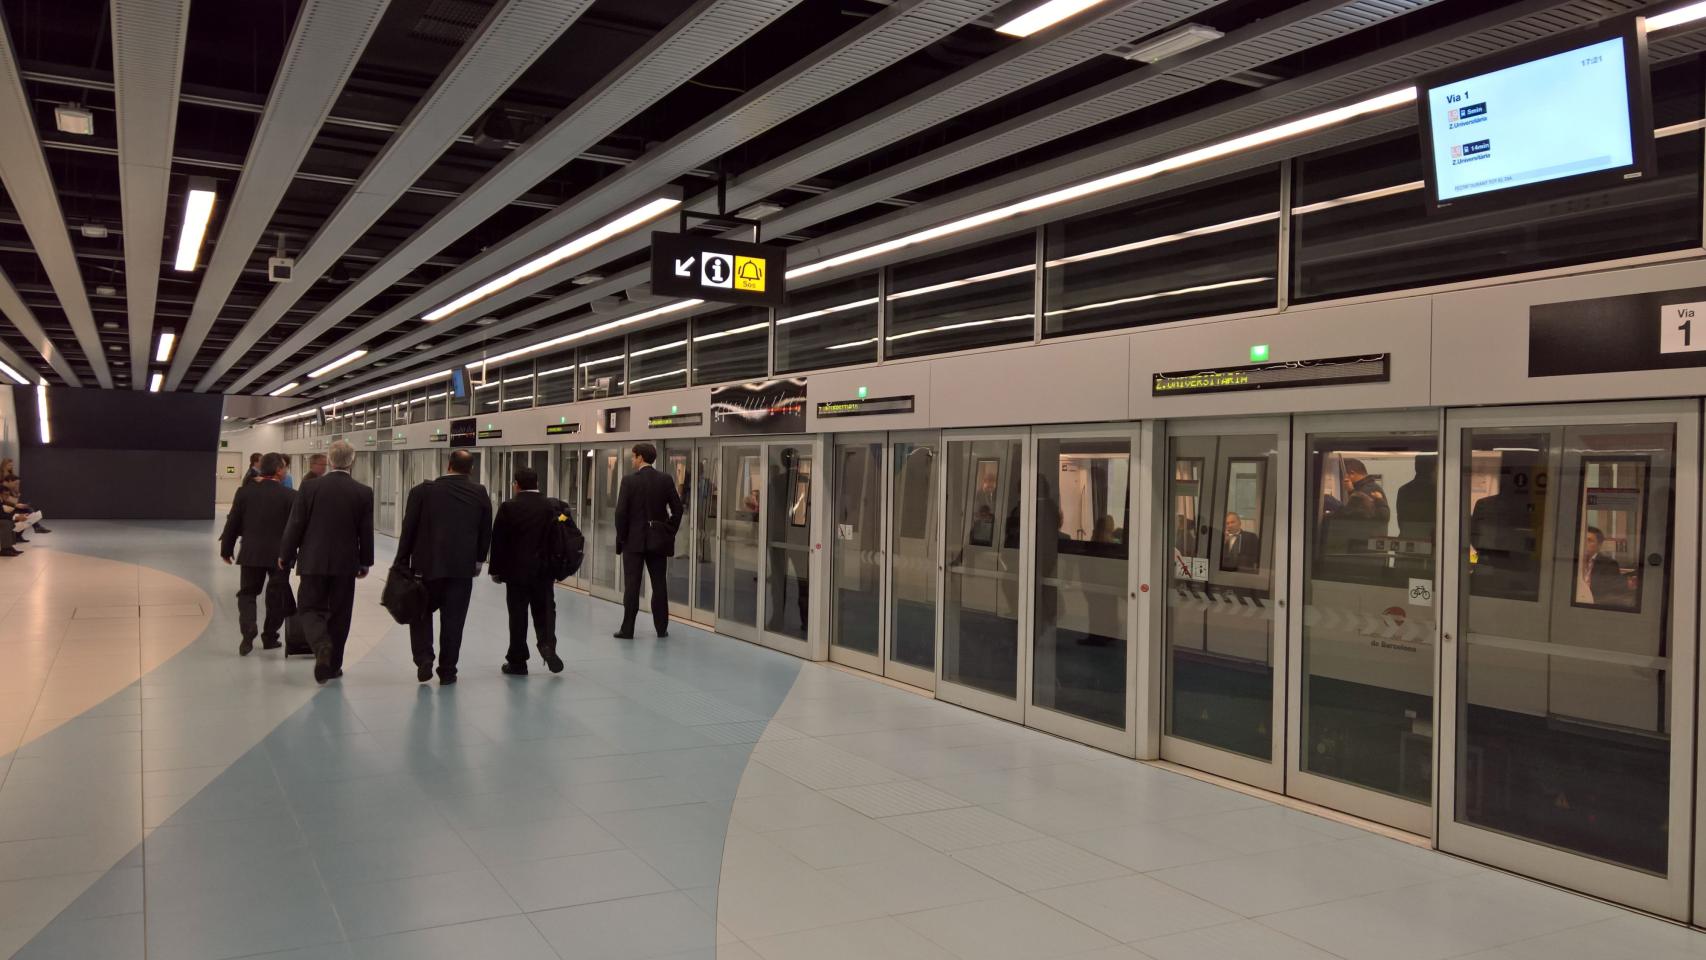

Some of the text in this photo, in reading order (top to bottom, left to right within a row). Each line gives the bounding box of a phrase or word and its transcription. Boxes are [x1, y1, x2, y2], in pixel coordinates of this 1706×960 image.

[1447, 91, 1469, 104] Via 1
[1678, 309, 1695, 318] Via
[1678, 320, 1691, 346] 1
